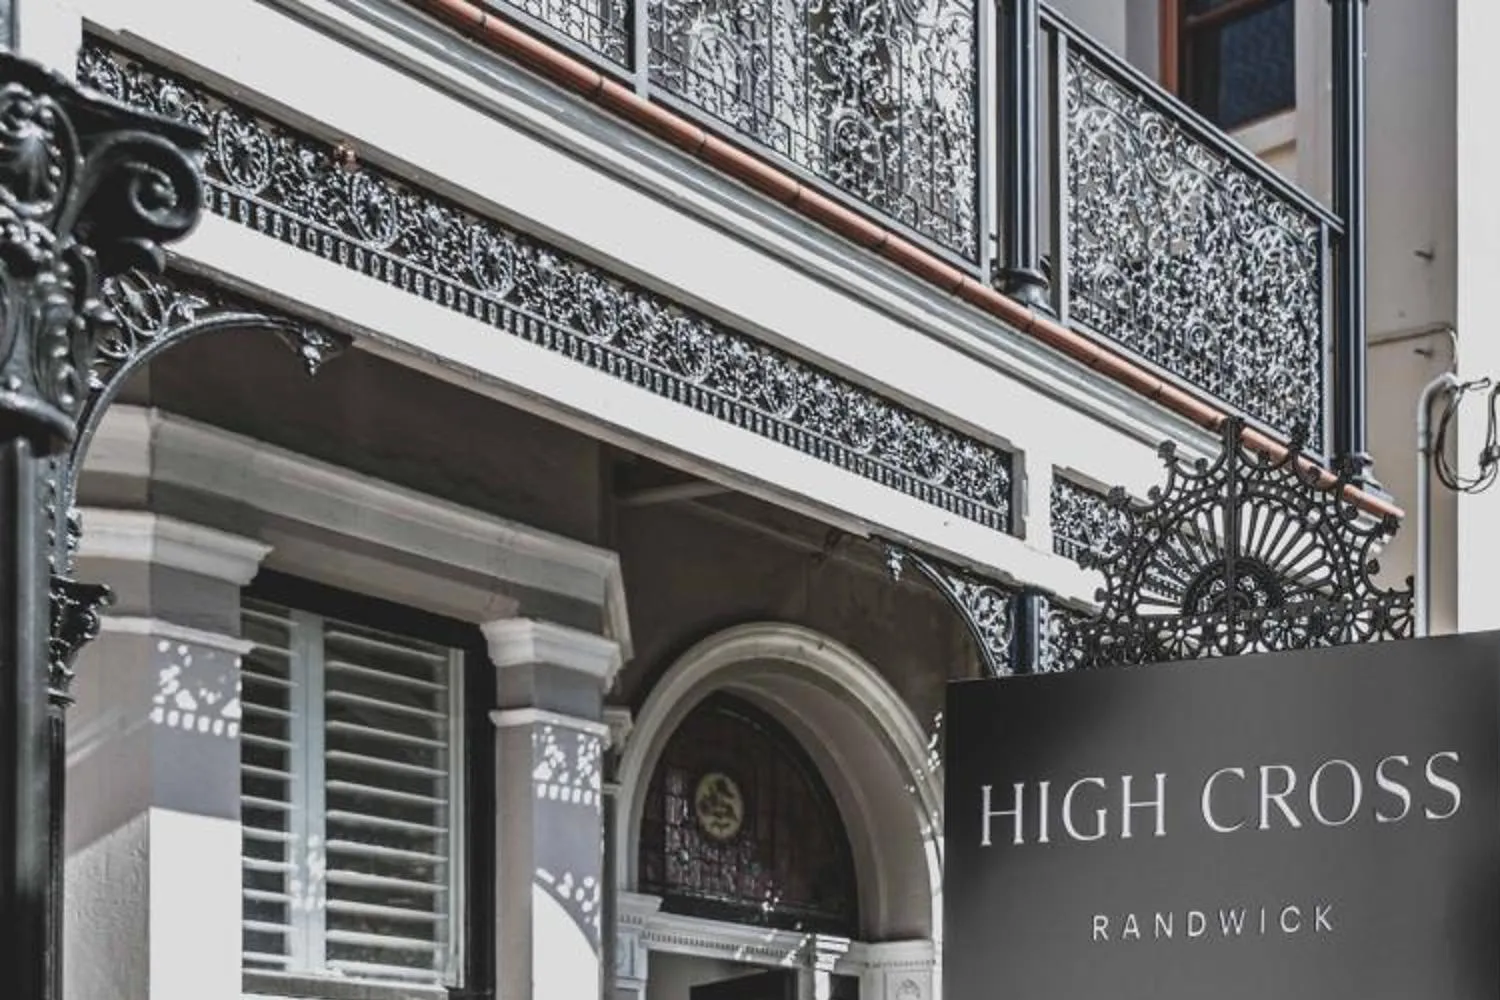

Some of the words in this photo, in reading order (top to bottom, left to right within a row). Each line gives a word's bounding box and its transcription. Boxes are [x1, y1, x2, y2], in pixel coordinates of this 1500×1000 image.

[980, 772, 1167, 847] HIGH
[1200, 751, 1463, 833] CROSS
[1091, 904, 1334, 941] RANDWICK
